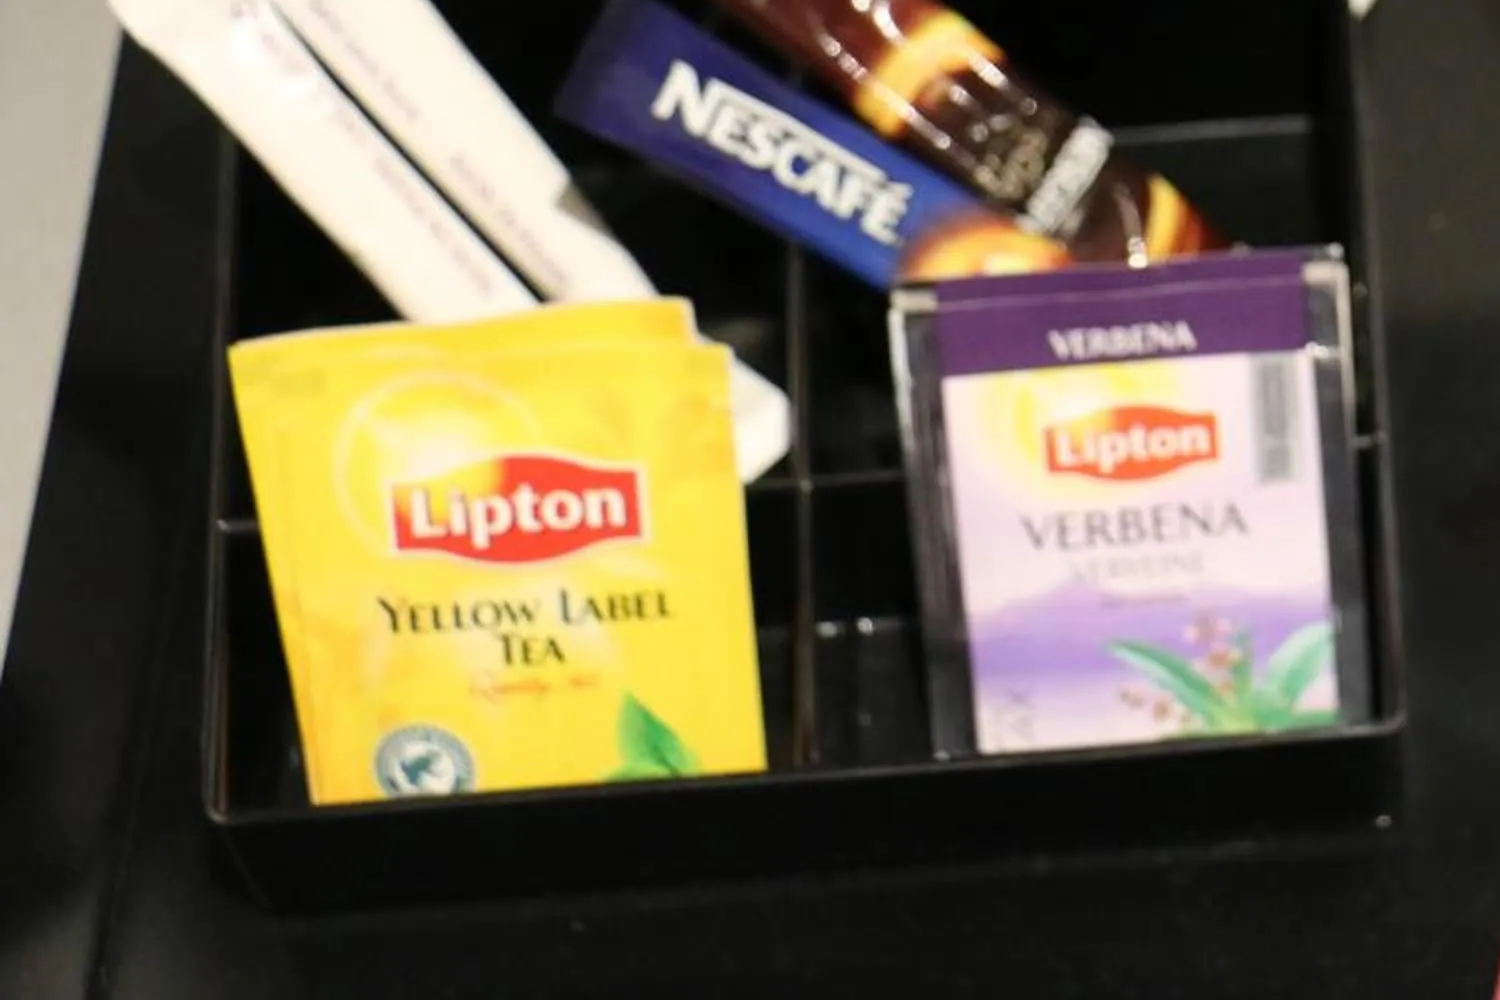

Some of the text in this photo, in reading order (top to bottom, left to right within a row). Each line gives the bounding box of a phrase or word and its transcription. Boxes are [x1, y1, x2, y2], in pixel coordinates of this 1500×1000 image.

[1046, 320, 1198, 361] VERBENA
[1054, 421, 1212, 474] Lipton
[407, 482, 627, 550] Lipton
[1019, 500, 1249, 553] VERBENA
[376, 586, 671, 634] YELLOW LABEL
[497, 630, 567, 668] TEA
